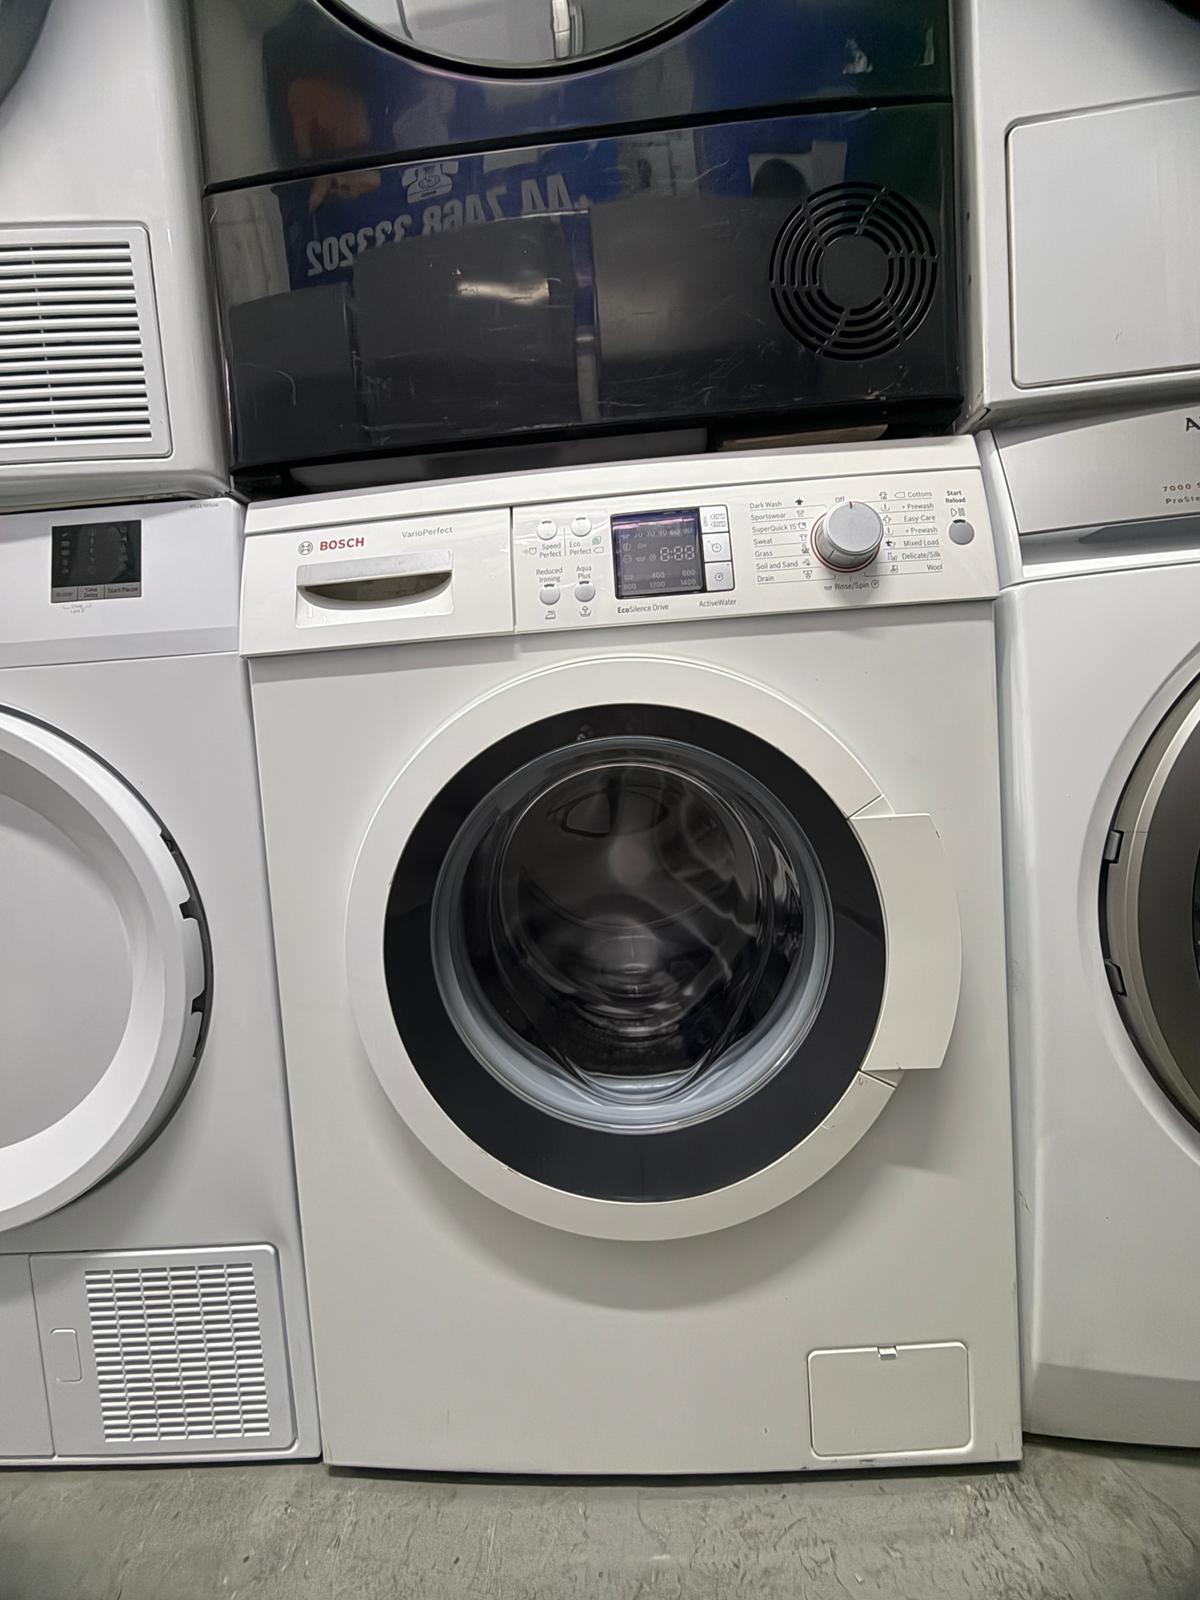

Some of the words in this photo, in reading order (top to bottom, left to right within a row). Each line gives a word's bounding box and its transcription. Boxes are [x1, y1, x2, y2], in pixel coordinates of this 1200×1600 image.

[1185, 417, 1200, 432] A
[1162, 483, 1191, 492] 7000
[750, 513, 786, 521] Sportswear
[402, 526, 453, 539] VarioPerfect
[752, 524, 788, 533] SuperQuick
[319, 537, 365, 551] BOSCH
[541, 542, 561, 551] Speed
[539, 550, 562, 558] Perfect
[902, 552, 941, 560] Delicate/Silk
[756, 562, 768, 570] Soil
[769, 561, 781, 569] and
[782, 560, 799, 568] Sand
[536, 567, 563, 575] Reduced
[834, 581, 870, 590] Rinse/Spin
[699, 598, 737, 608] ActiveWater
[617, 604, 652, 614] EcoSilence
[652, 603, 669, 611] Drive
